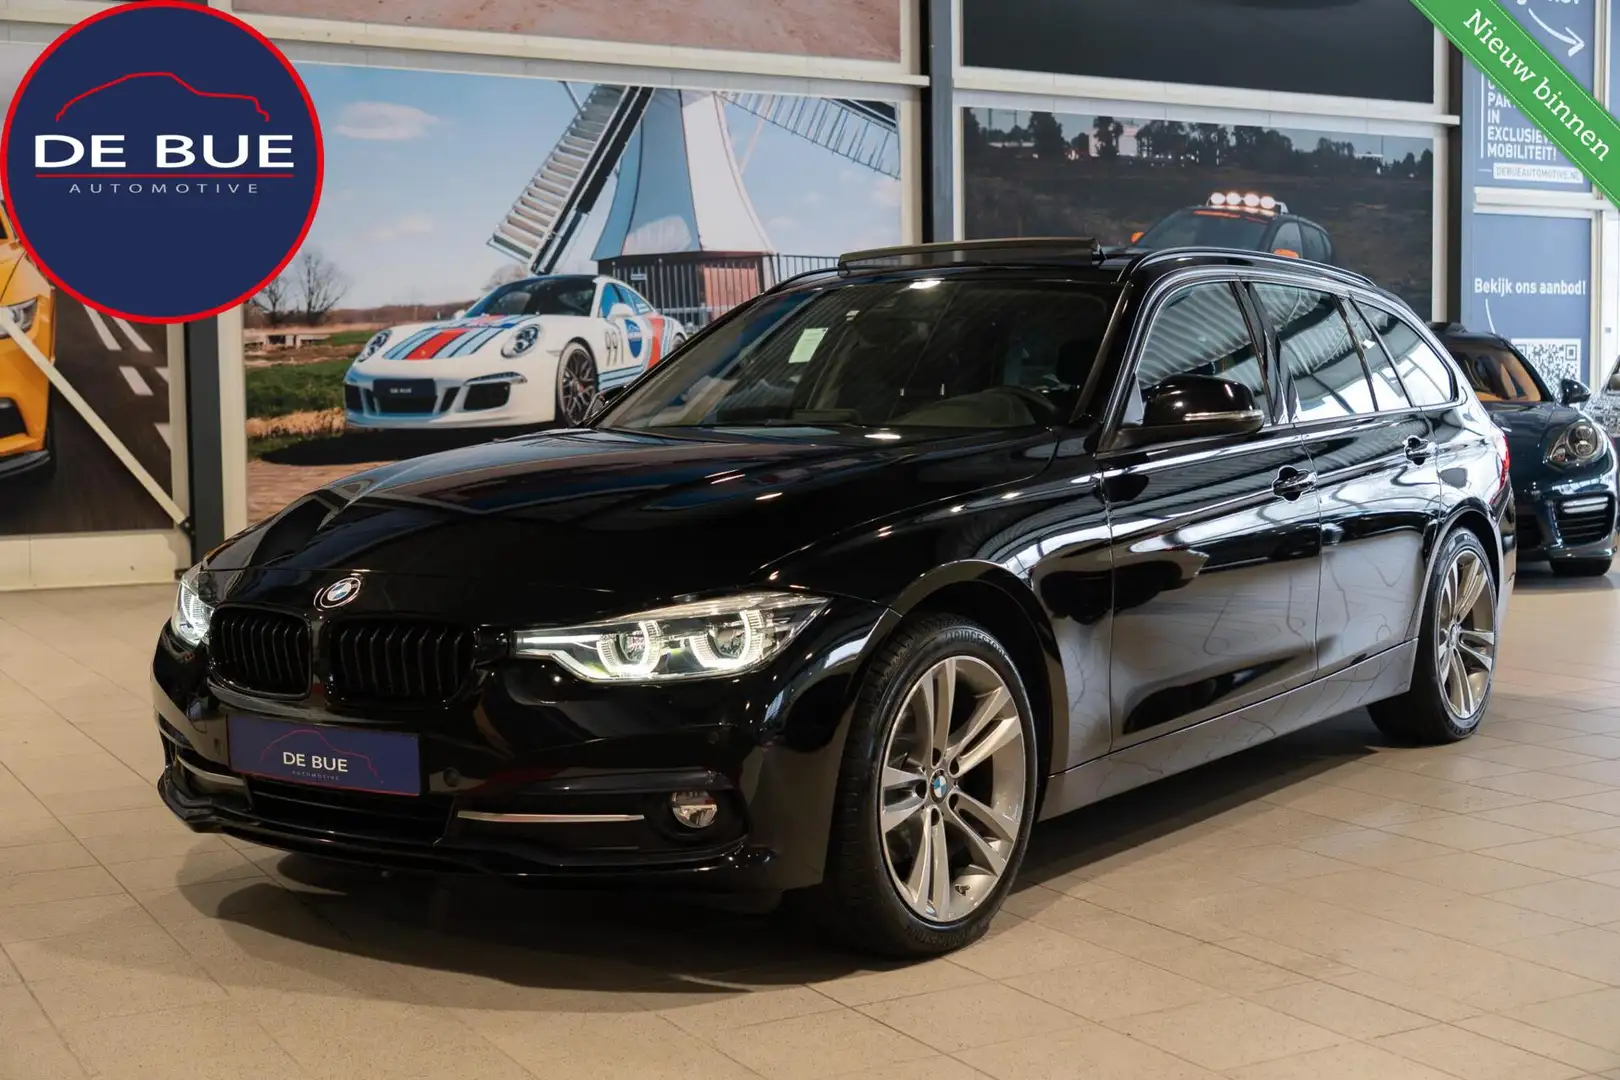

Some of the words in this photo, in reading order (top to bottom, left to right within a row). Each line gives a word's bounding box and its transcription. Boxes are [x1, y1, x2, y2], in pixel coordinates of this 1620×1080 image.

[1487, 91, 1516, 108] PAR
[1487, 109, 1500, 124] IN
[1487, 142, 1557, 161] MOBILITEIT!
[1474, 277, 1512, 297] Bekijk
[1515, 282, 1537, 294] ons
[1539, 279, 1586, 295] aanbod!
[604, 329, 624, 366] 991
[283, 751, 306, 767] DE
[311, 755, 349, 772] BUE
